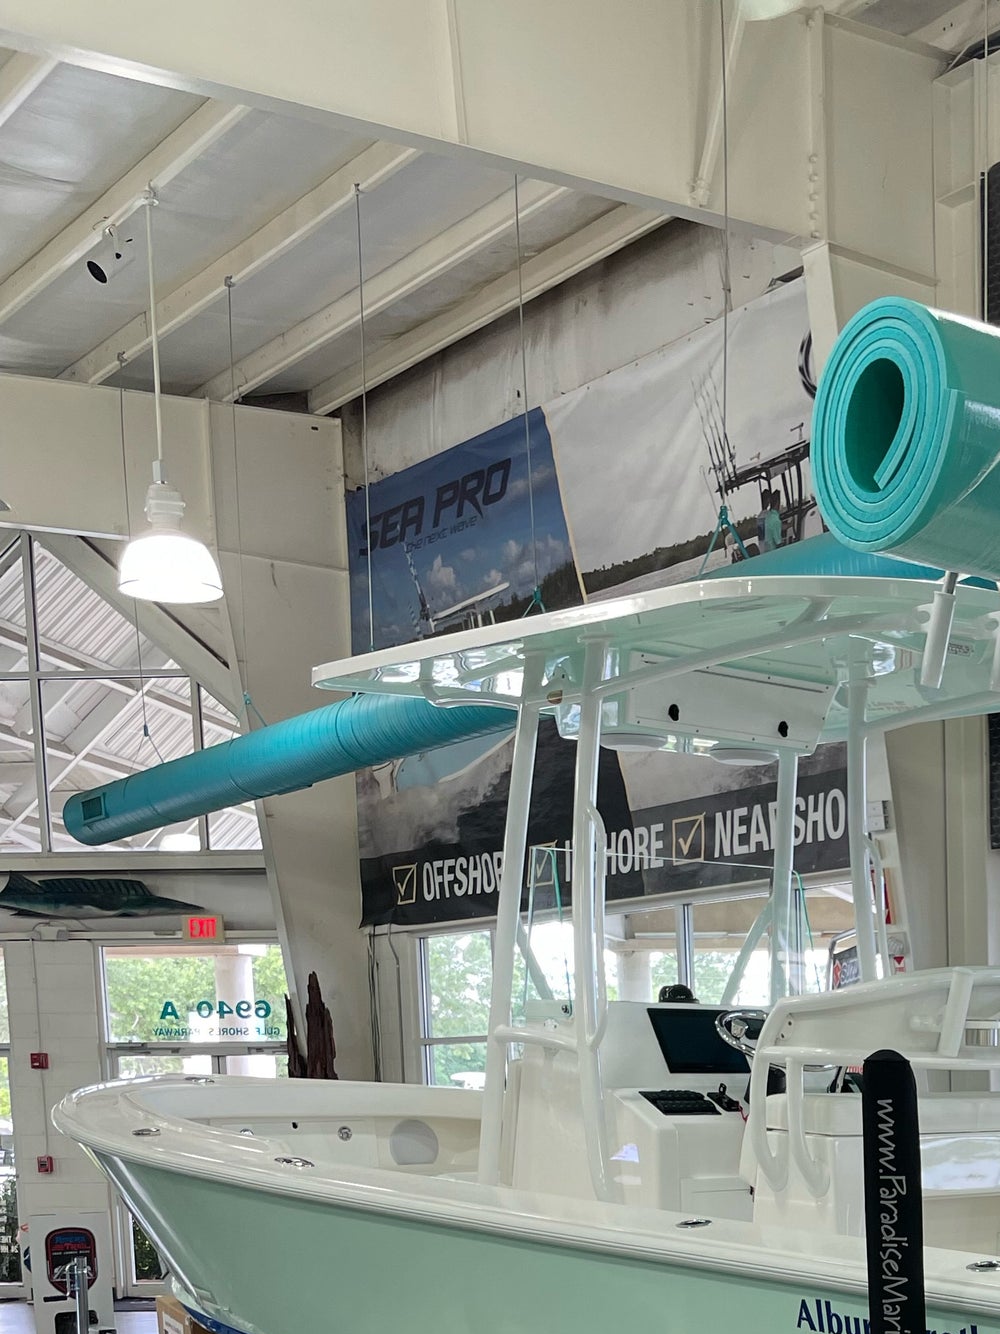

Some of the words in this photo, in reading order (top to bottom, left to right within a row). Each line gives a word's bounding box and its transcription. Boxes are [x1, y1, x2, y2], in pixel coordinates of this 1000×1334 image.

[358, 495, 425, 556] SEA
[432, 457, 512, 529] PRO
[422, 851, 504, 901] OFFSHOR
[564, 823, 664, 883] IHORE
[188, 917, 217, 939] EXIT
